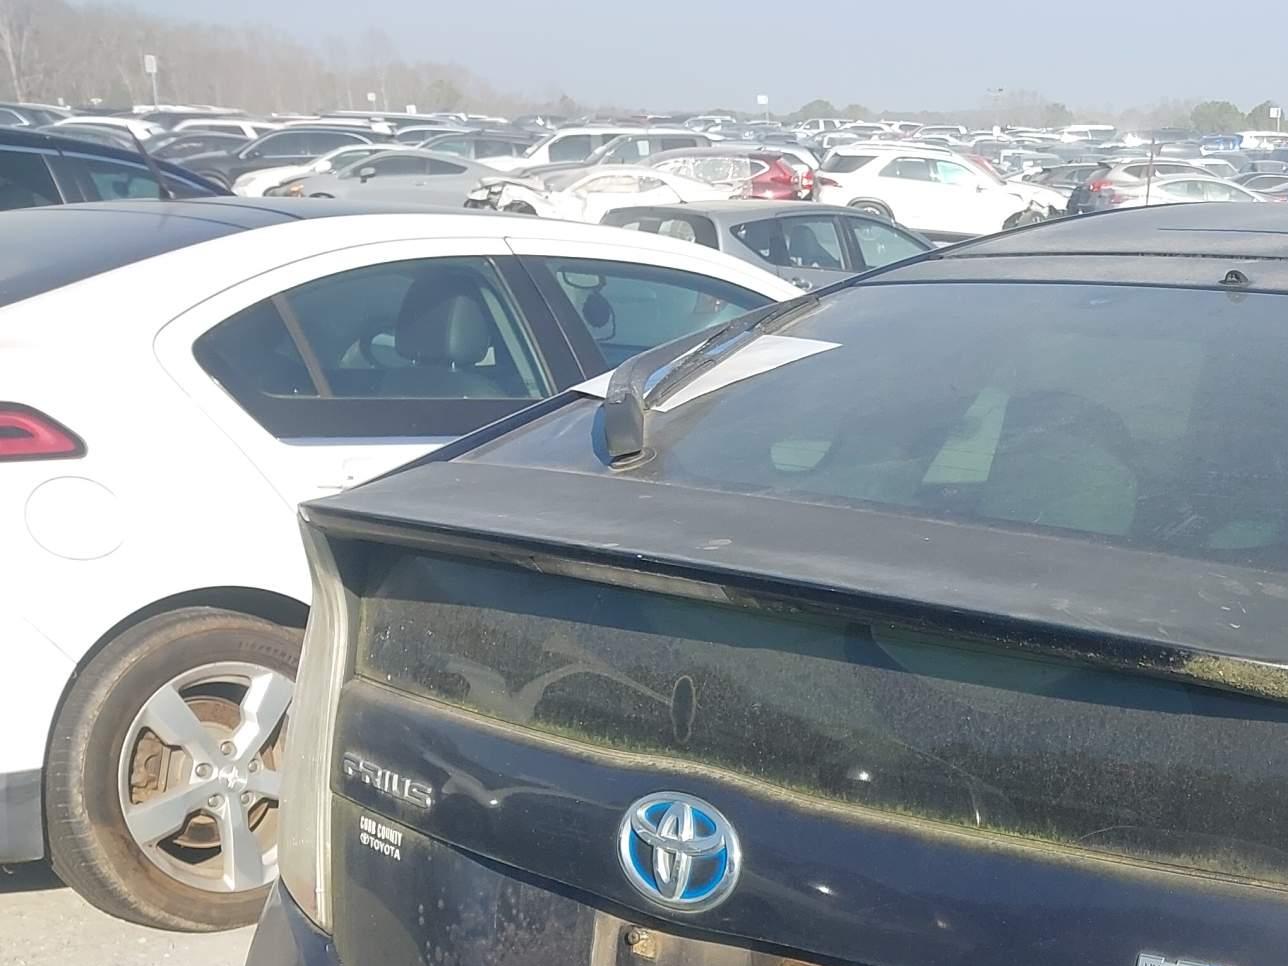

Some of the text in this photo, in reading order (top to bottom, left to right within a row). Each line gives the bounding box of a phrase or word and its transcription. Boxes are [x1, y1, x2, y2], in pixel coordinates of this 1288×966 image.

[343, 751, 433, 809] PRIUS
[377, 825, 403, 846] COUNTY
[369, 837, 401, 861] TOYOTA
